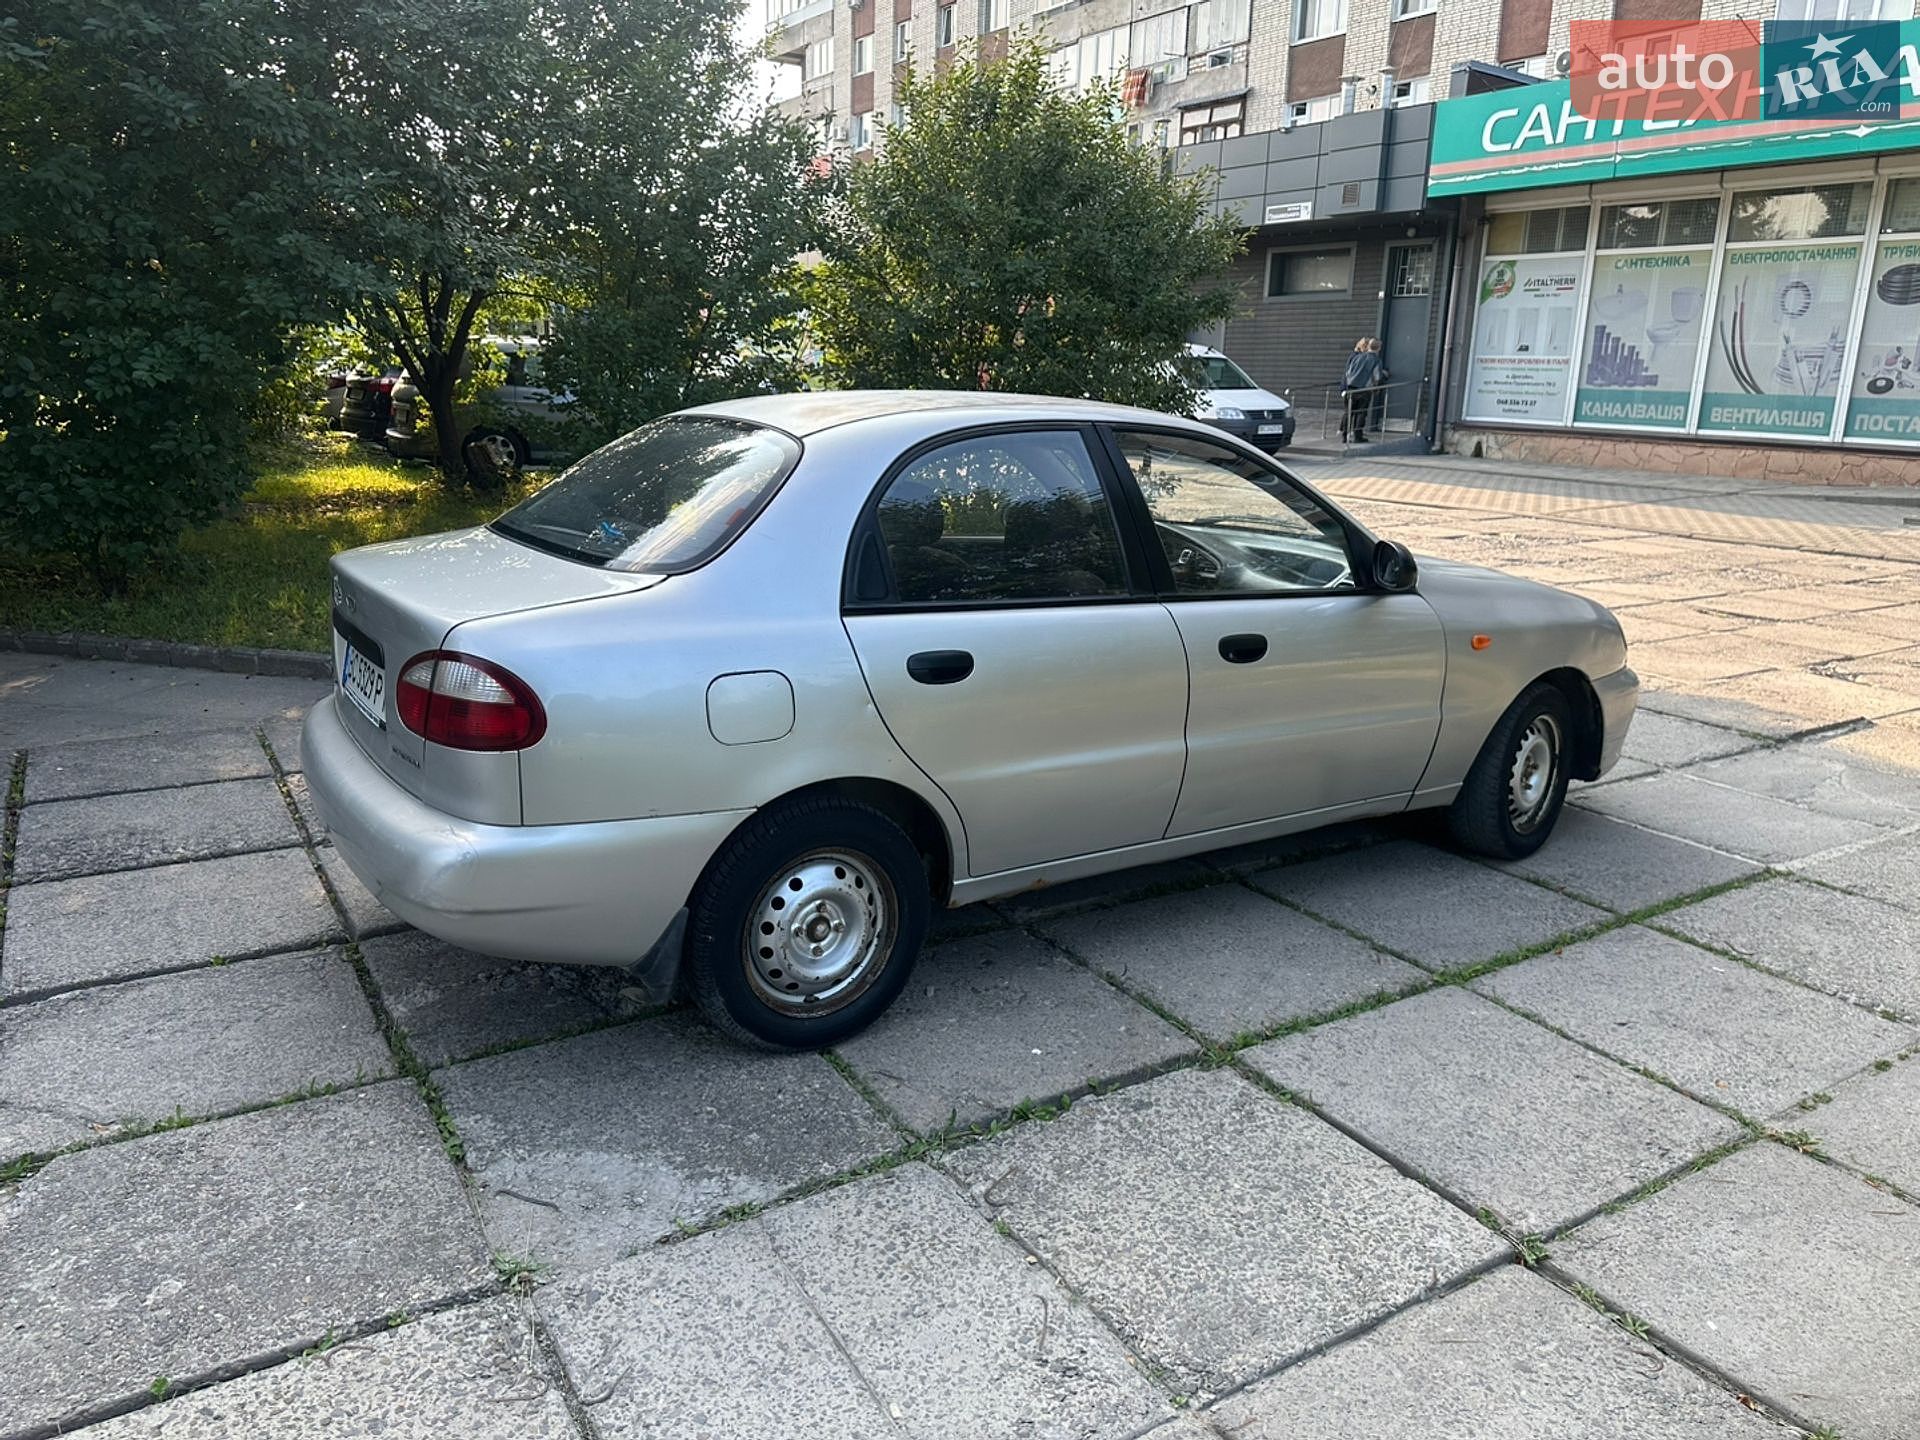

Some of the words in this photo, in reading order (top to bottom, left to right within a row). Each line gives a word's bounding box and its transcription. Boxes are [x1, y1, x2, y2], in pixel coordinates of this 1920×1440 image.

[1614, 255, 1691, 270] САНТЕХНІКА
[1730, 247, 1857, 264] ЕЛЕКТРОПОСТАЧАННЯ
[1533, 277, 1576, 287] ITALTHERM
[1581, 400, 1685, 421] КАНАЛІЗАЦІЯ
[1710, 407, 1825, 428] ВЕНТИЛЯЦІЯ
